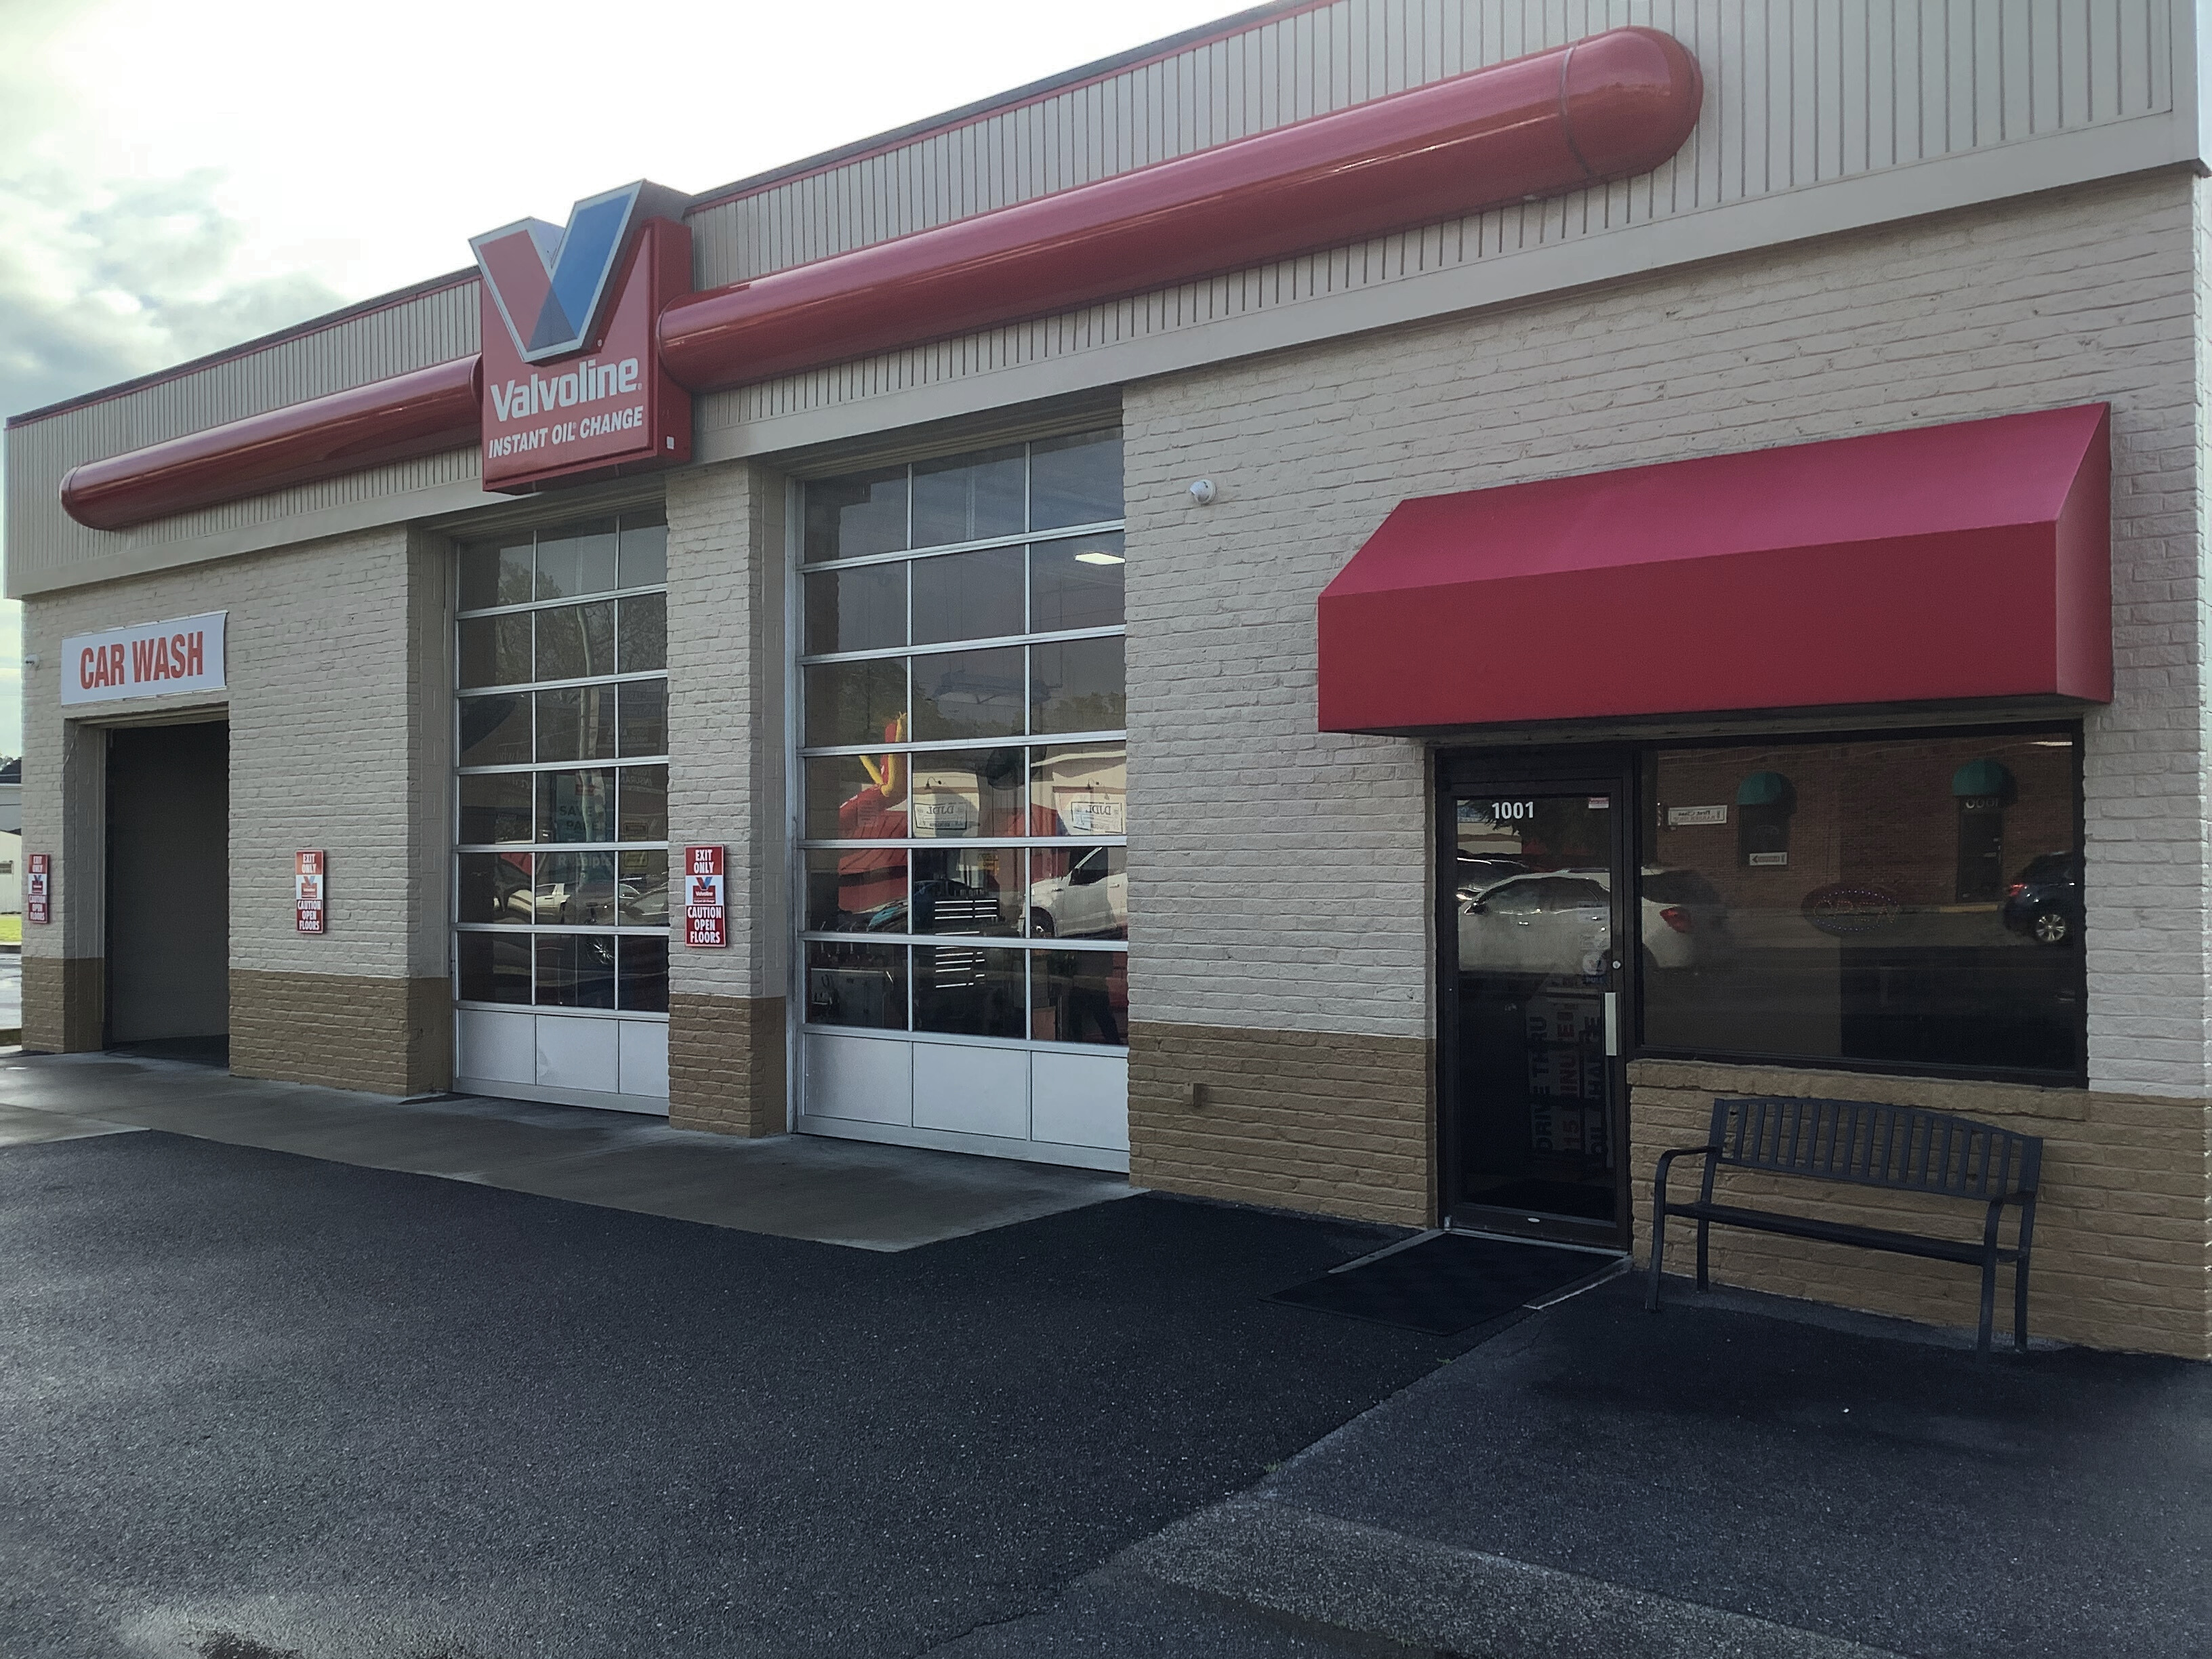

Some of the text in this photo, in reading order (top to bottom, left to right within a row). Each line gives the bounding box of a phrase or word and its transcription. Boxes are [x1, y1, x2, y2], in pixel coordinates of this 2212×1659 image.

[490, 357, 638, 422] Valvoline
[489, 405, 644, 459] INSTANT OIL CHANGE
[80, 631, 203, 690] CAR WASH
[1492, 801, 1534, 819] 1001
[302, 853, 316, 863] EXIT
[695, 849, 713, 861] EXIT
[302, 863, 316, 874] ONLY
[693, 861, 714, 874] ONLY
[298, 900, 321, 910] CAUTION
[302, 910, 316, 920] OPEN
[687, 906, 722, 919] CAUTION
[299, 920, 320, 930] FLOORS
[694, 918, 716, 931] OPEN
[690, 931, 721, 944] FLOORS
